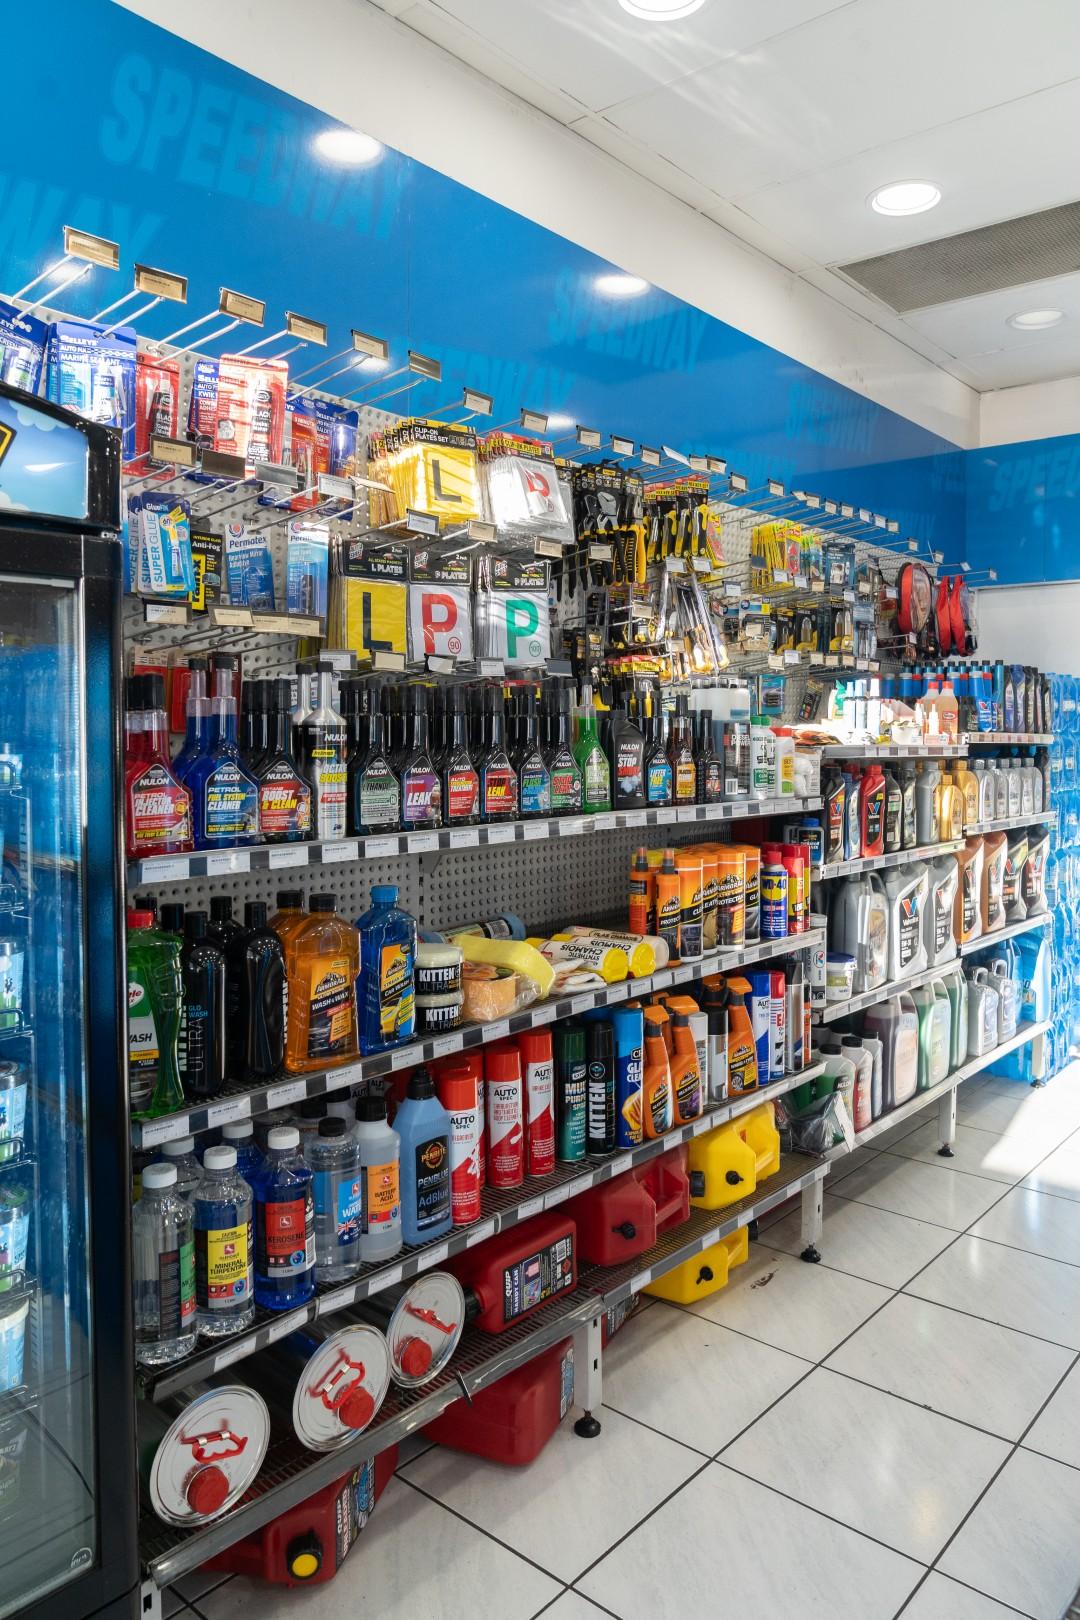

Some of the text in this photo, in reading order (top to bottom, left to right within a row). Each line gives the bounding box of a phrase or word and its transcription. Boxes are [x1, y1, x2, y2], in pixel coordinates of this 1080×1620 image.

[99, 52, 405, 242] SPEEDWAY
[414, 426, 438, 435] CLIP-ON
[415, 432, 449, 443] PLATES SET
[432, 460, 462, 503] L
[192, 540, 221, 551] Anti-Fog
[229, 536, 267, 548] Permatex
[149, 514, 163, 583] SUPER GLUE
[377, 565, 403, 574] PLATES
[441, 571, 467, 580] PLATES
[520, 577, 544, 586] PLATES
[362, 592, 393, 650] L
[422, 593, 457, 654] P
[505, 599, 539, 659] P
[617, 757, 637, 767] STOP
[367, 768, 388, 776] NULON
[139, 777, 169, 786] NULON
[262, 790, 295, 801] BOOST
[487, 785, 507, 796] LEAK
[208, 794, 223, 802] FUEL
[407, 792, 432, 806] LEAK
[208, 801, 242, 811] CLEANER
[271, 799, 298, 809] CLEAN
[135, 804, 175, 816] CLEANER
[762, 879, 787, 890] WD-40
[560, 944, 603, 955] CHAMOIS
[591, 940, 632, 951] CHAMOIS
[568, 951, 600, 961] SYNTHETIC
[419, 968, 454, 982] KITTEN
[384, 980, 410, 997] CAR WASH
[418, 980, 448, 992] ULTRA
[312, 999, 331, 1010] WASH
[334, 992, 349, 1003] WAX
[426, 1005, 459, 1022] KITTEN
[129, 1032, 153, 1043] ASH
[188, 1018, 204, 1072] ULTRA
[494, 1088, 518, 1097] AUTO
[589, 1082, 606, 1139] KITTEN
[450, 1115, 475, 1125] AUTO
[421, 1147, 447, 1163] PENRITE
[418, 1168, 449, 1185] PENBLUE
[419, 1187, 448, 1208] AdBlue
[268, 1232, 304, 1245] KEROSENE
[210, 1263, 247, 1275] TURPENTINE
[214, 1259, 243, 1269] MINERAL
